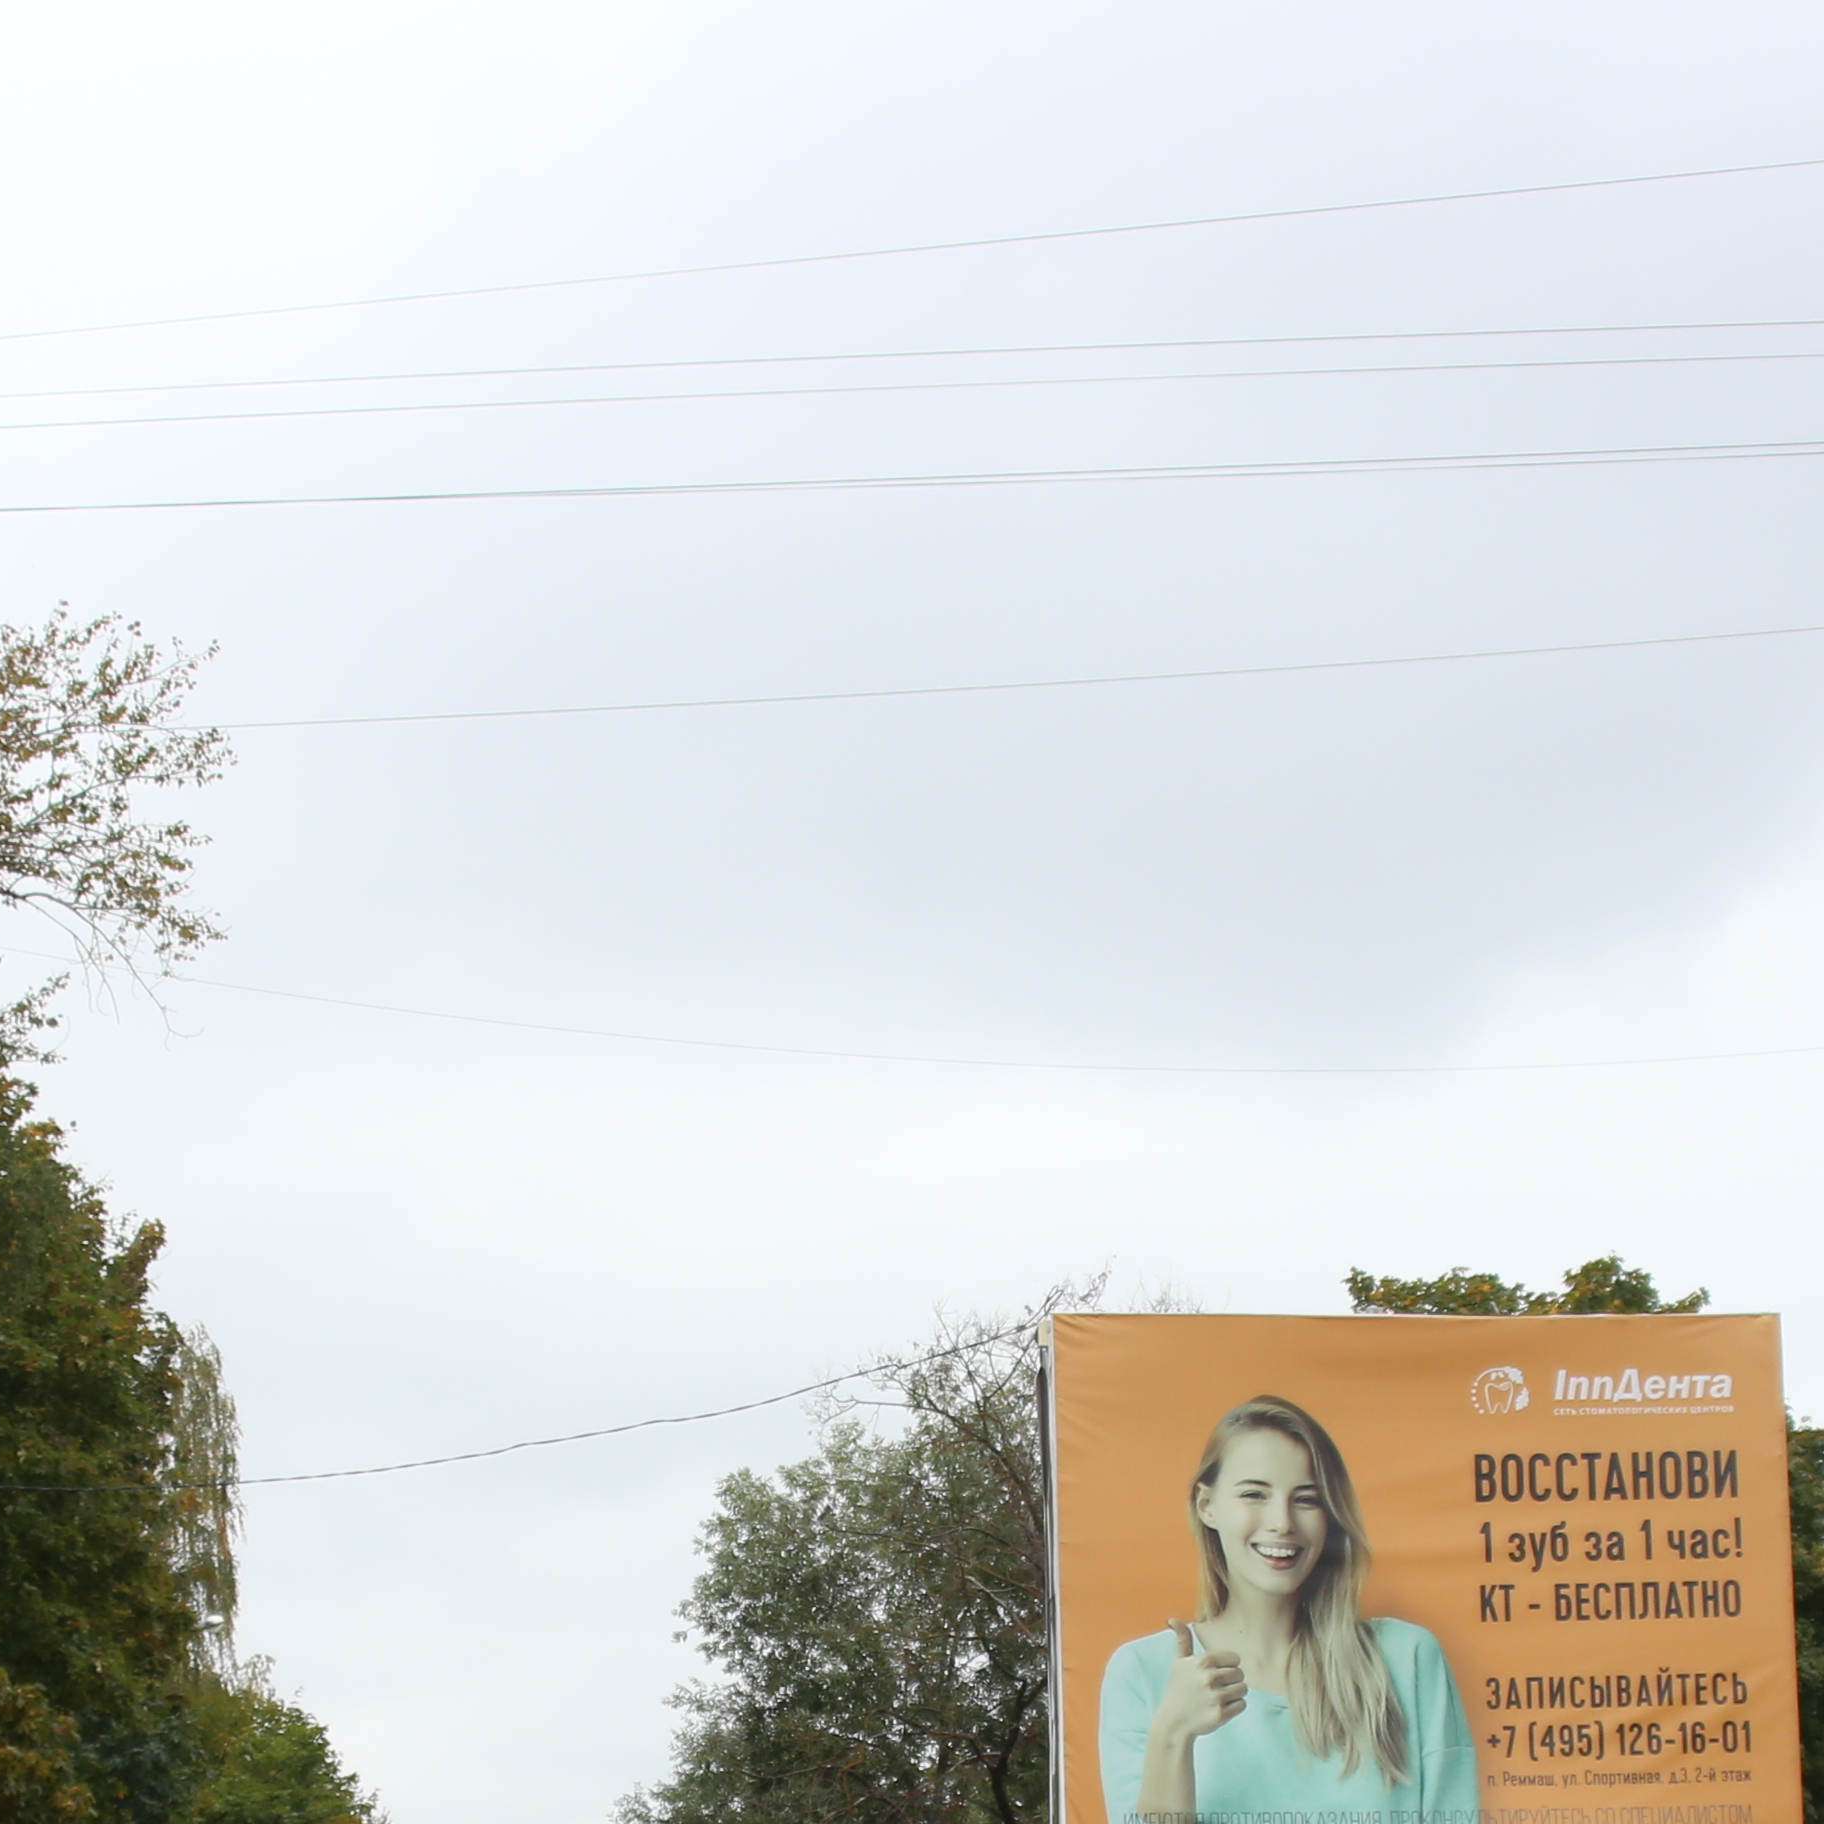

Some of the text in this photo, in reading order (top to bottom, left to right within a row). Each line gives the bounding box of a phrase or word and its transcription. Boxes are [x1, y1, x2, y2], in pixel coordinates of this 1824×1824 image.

[1553, 1404, 1735, 1415] СЕТЬ СТОМАТОЛОГИЧЕСКИХ ЦЕНТРОВ
[1475, 1450, 1739, 1502] ВОССТАНОВИ
[1480, 1517, 1743, 1572] 1 зуб за 1 час!
[1480, 1584, 1515, 1622] КТ
[1554, 1580, 1742, 1621] БЕСПЛАТНО
[1486, 1667, 1749, 1710] ЗАПИСЫВАЙТЕСЬ
[1487, 1720, 1751, 1761] +7 (495) 126-16-01
[1487, 1774, 1499, 1787] п.
[1503, 1771, 1558, 1787] Реммаш,
[1562, 1773, 1580, 1789] ул.
[1584, 1769, 1664, 1788] Спортивная,
[1695, 1766, 1717, 1783] 2-й
[1721, 1768, 1752, 1782] этаж
